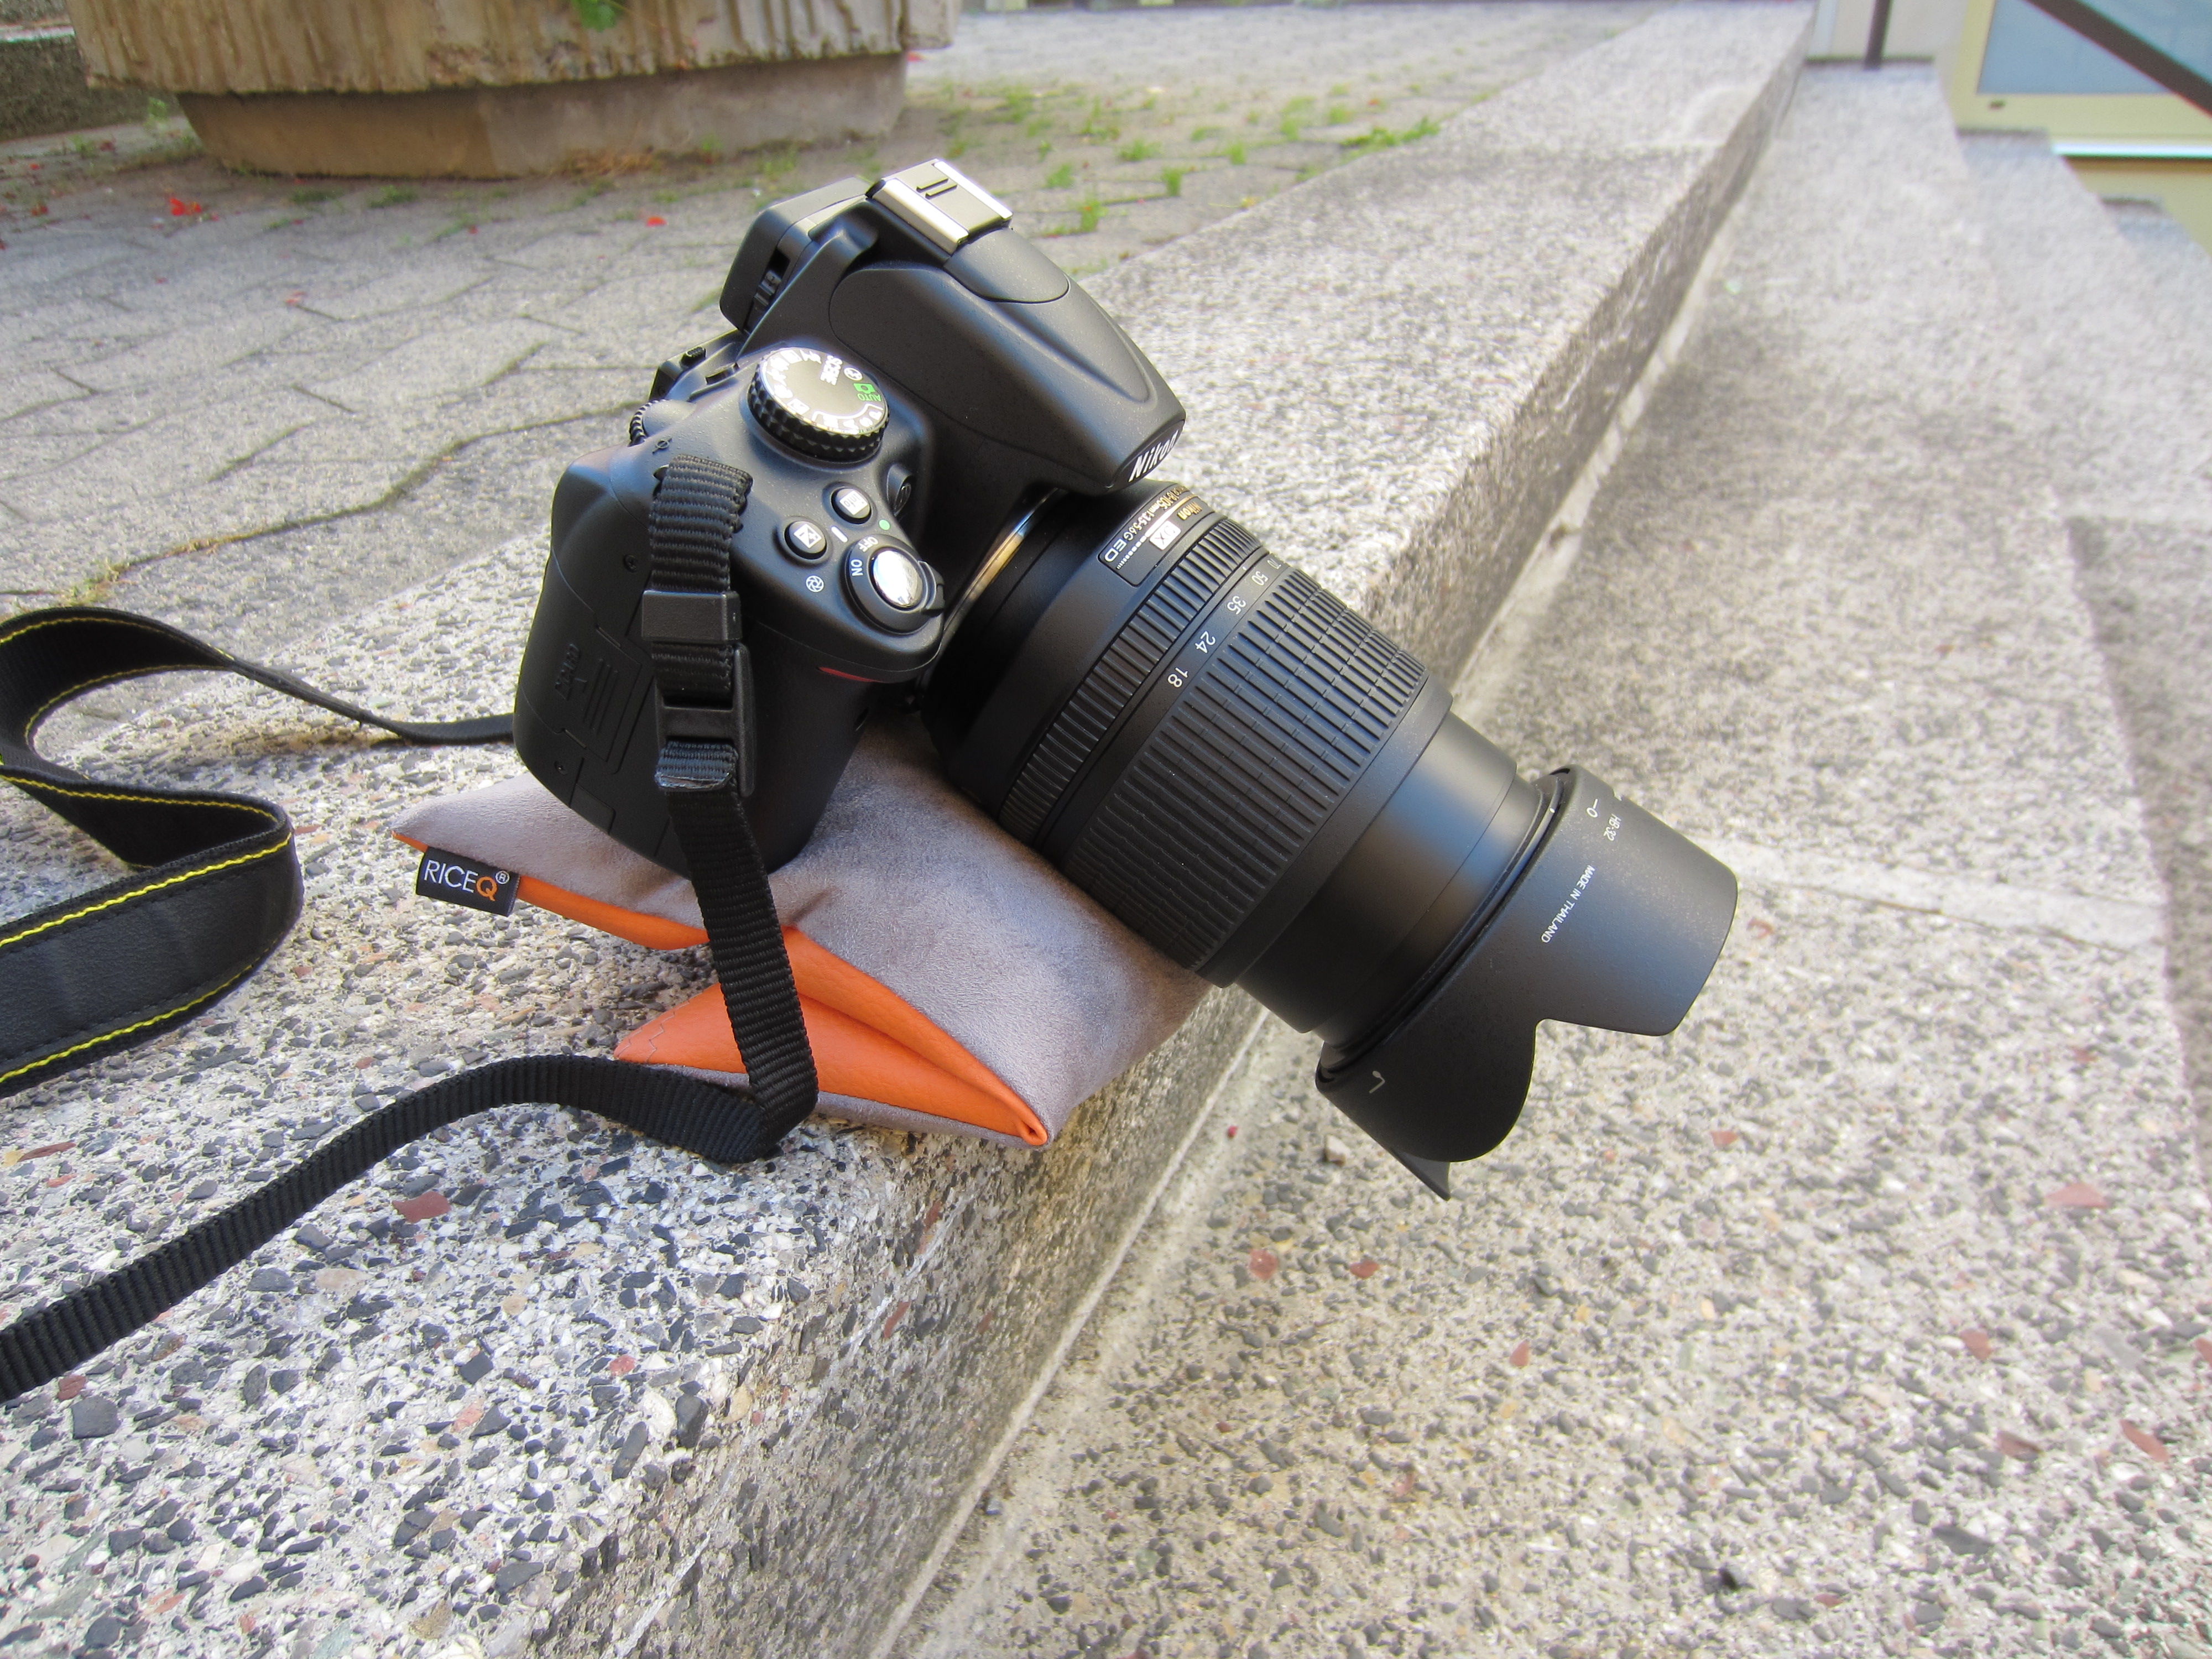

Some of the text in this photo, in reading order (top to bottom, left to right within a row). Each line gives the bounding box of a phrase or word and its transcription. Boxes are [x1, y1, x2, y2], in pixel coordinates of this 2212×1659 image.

[858, 393, 881, 401] AUTO
[1128, 429, 1179, 482] Nikon
[1177, 501, 1203, 520] Nikon
[857, 536, 879, 552] OFF
[1104, 538, 1127, 562] ED
[850, 559, 863, 577] ON
[1251, 571, 1269, 586] 50
[1227, 596, 1246, 615] 35
[1194, 631, 1216, 654] 24
[1167, 667, 1190, 688] 18
[1541, 864, 1596, 943] MADE IN THAILAND
